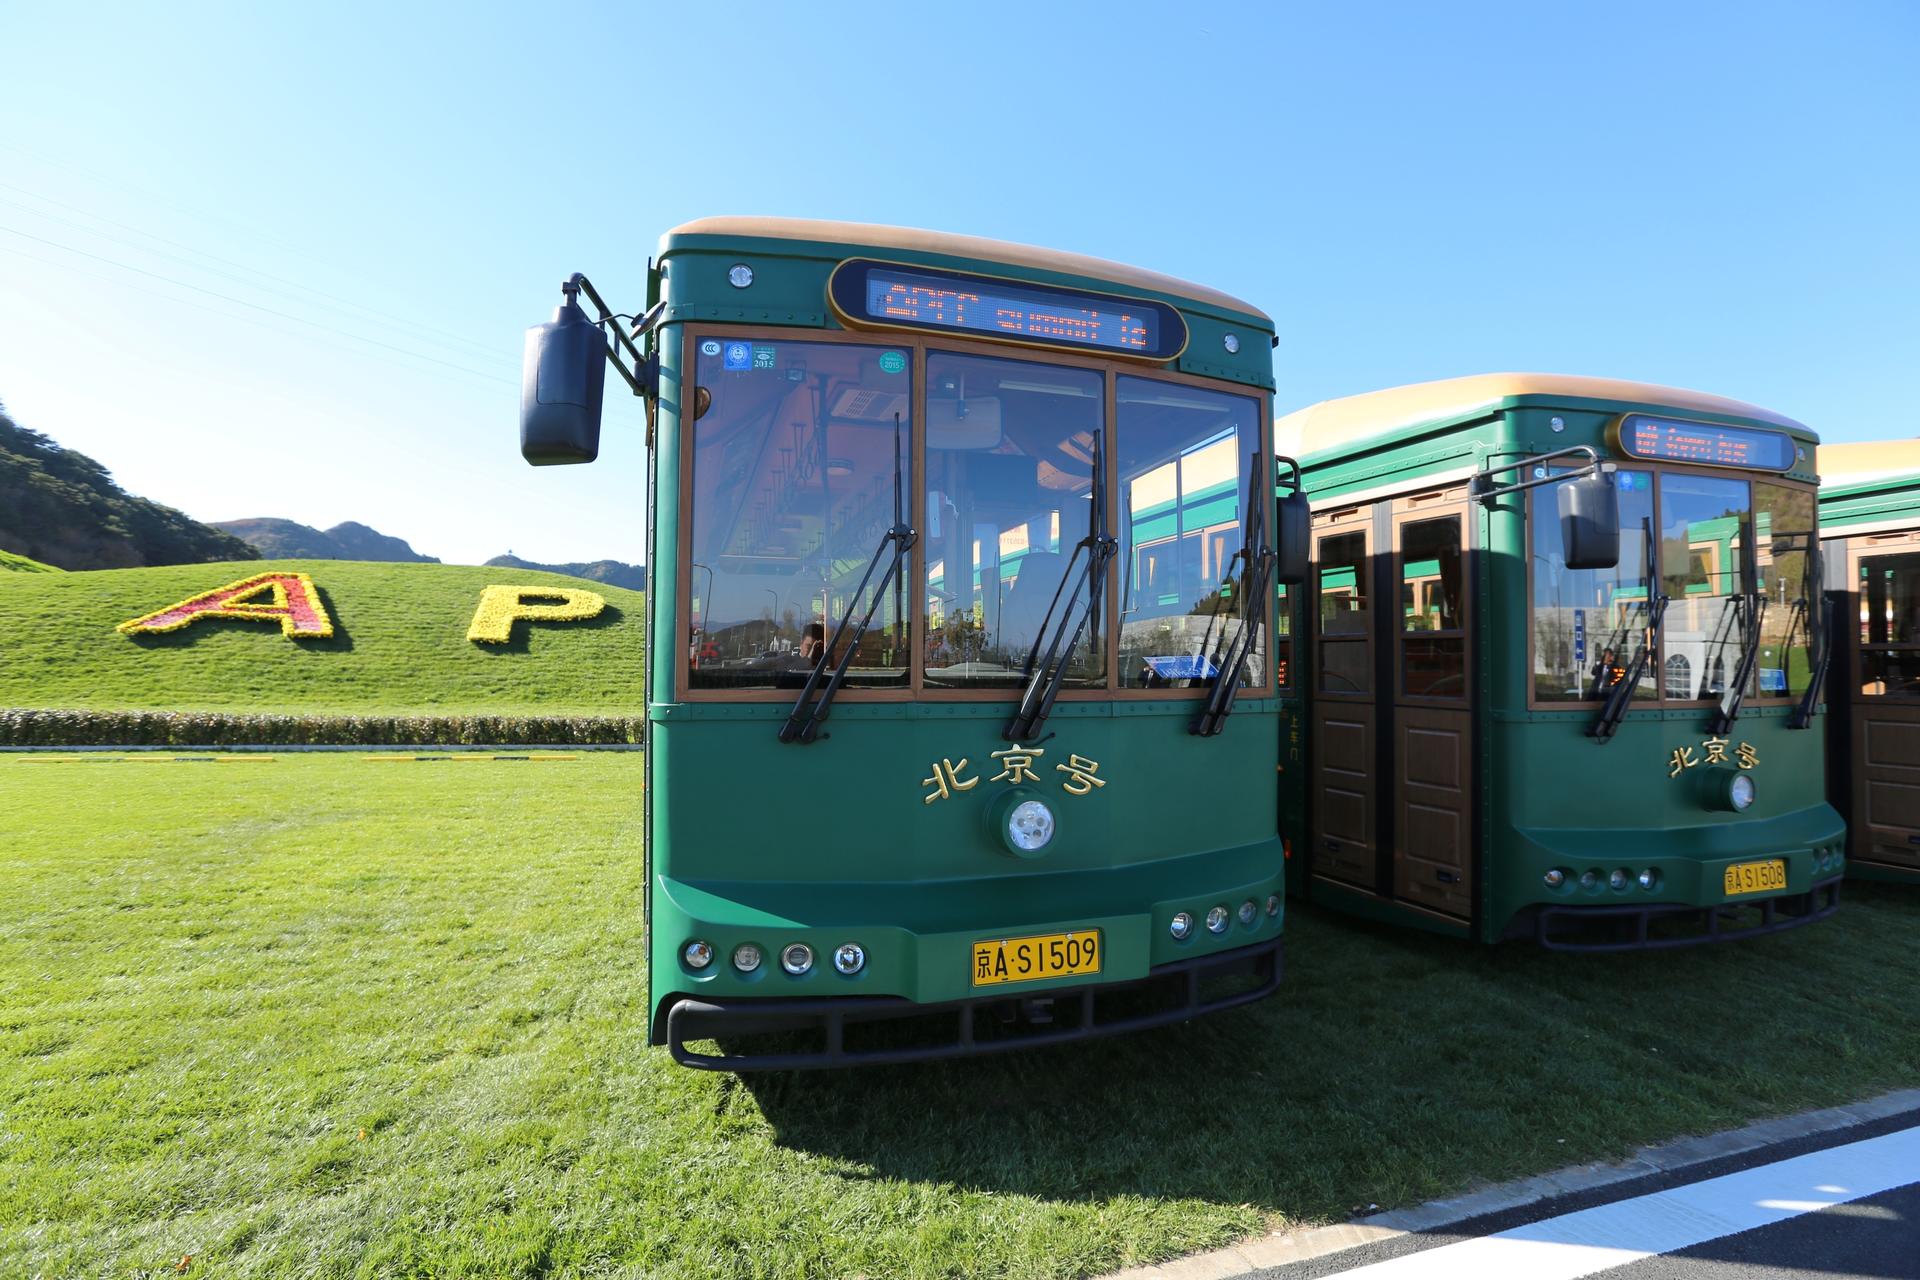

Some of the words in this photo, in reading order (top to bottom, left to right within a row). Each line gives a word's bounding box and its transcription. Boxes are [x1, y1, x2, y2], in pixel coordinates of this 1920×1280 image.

[754, 360, 774, 368] 2015
[884, 361, 900, 369] 2015
[1668, 736, 1760, 778] 北京号
[922, 743, 1107, 805] 北京号
